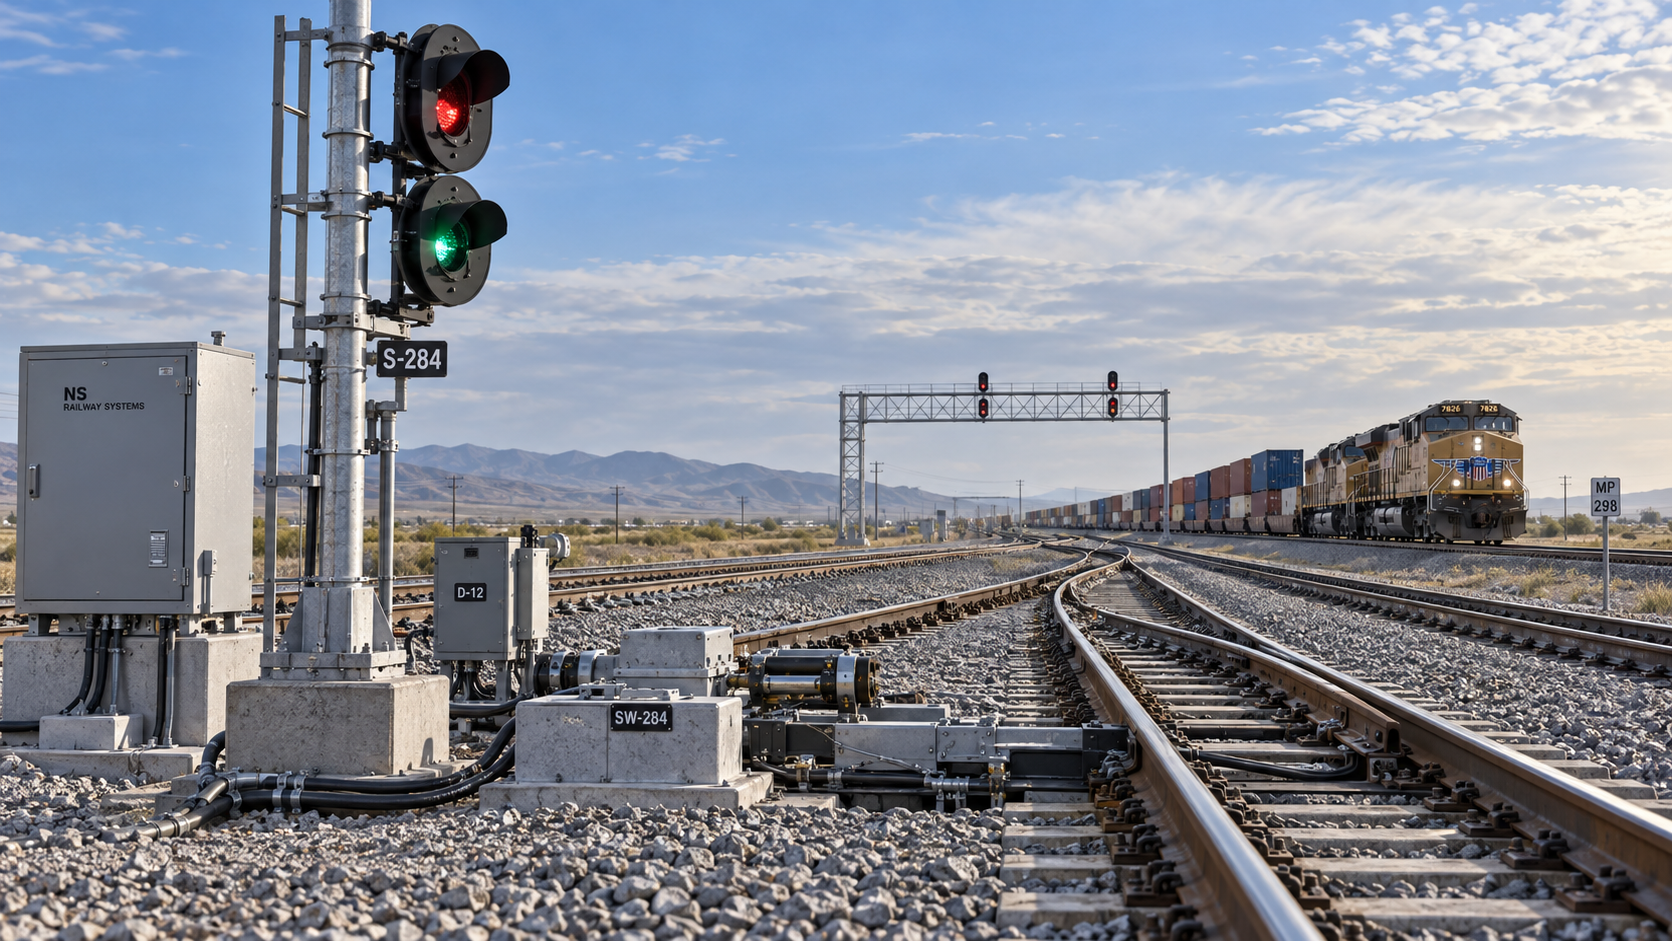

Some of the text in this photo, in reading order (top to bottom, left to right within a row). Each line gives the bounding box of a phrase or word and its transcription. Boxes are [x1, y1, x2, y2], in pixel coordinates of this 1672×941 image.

[383, 347, 442, 370] S-284
[64, 386, 87, 401] NS
[63, 402, 145, 411] RAILWAY SYSTEMS
[1596, 481, 1615, 493] MP
[1594, 499, 1617, 512] 298
[457, 586, 484, 599] D-12
[615, 710, 668, 725] SW-284
